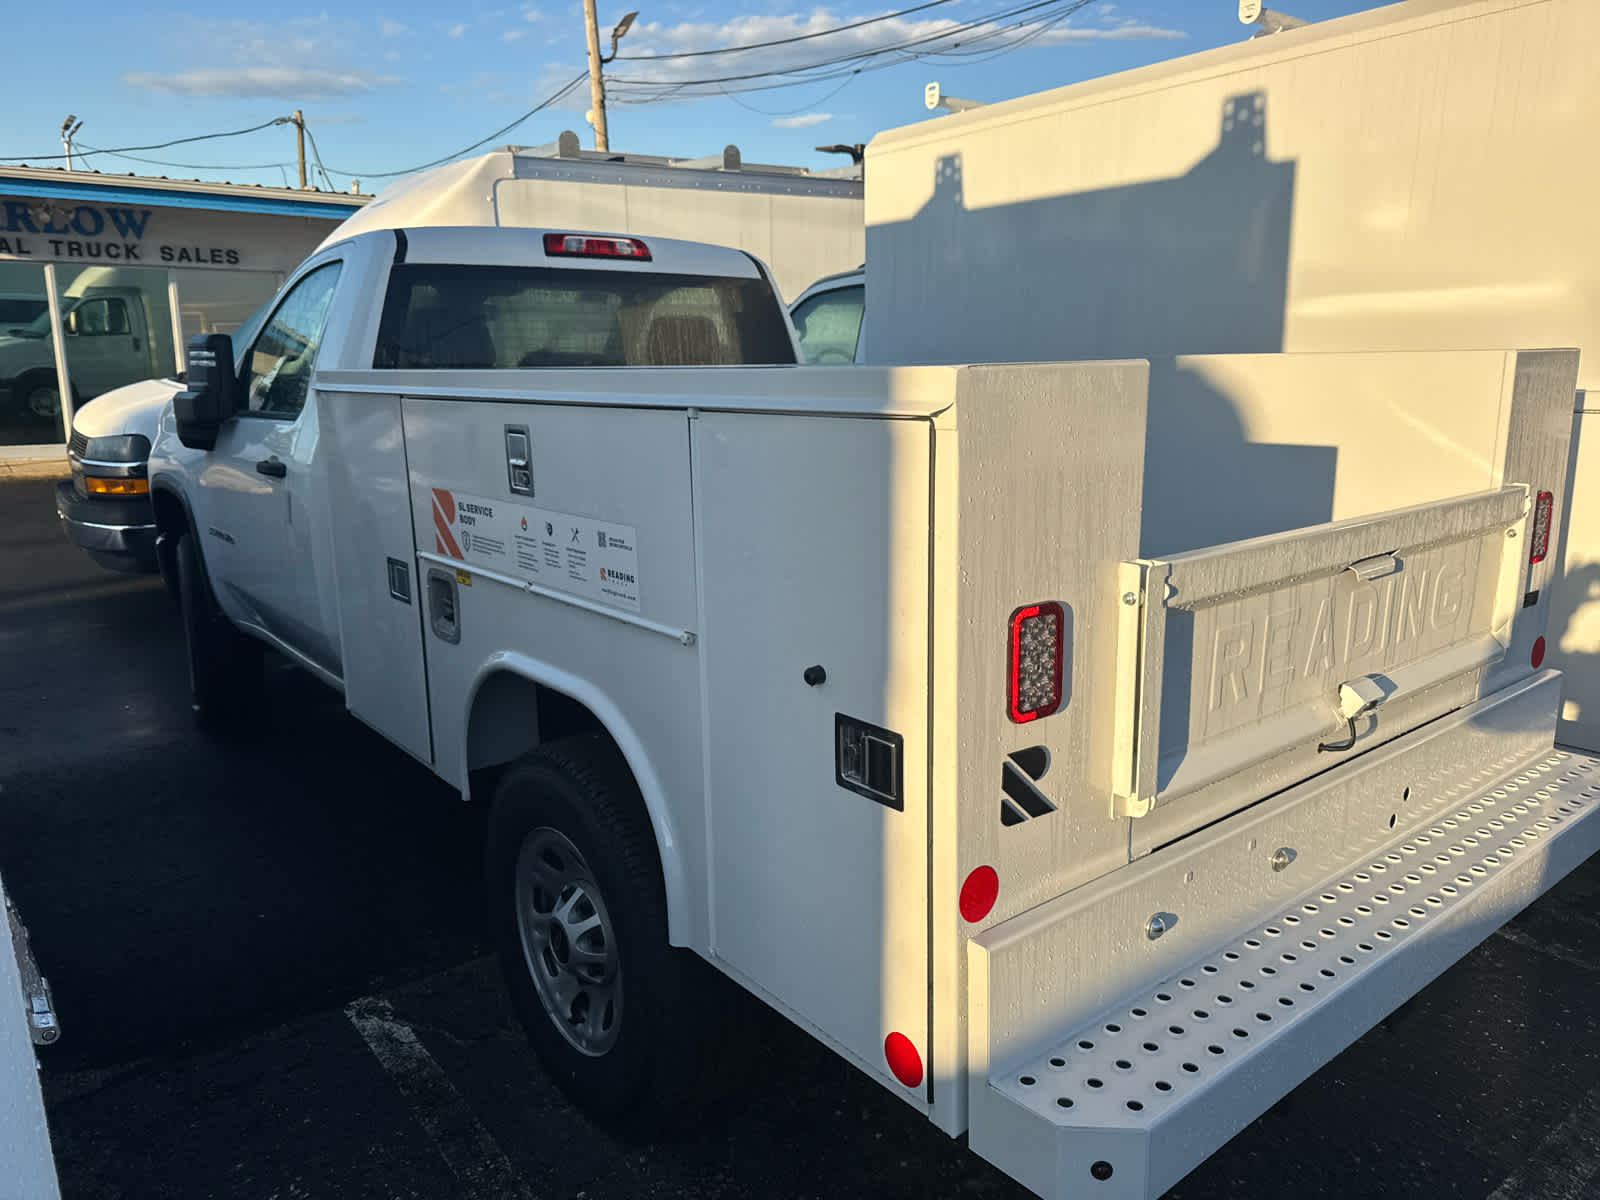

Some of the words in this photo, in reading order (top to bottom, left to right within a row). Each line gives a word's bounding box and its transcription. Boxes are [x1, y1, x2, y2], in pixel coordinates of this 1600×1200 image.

[49, 240, 139, 260] TRUCK
[160, 246, 240, 265] SALES
[466, 504, 493, 518] SERVICE
[607, 569, 635, 584] READING
[1208, 562, 1464, 712] READING
